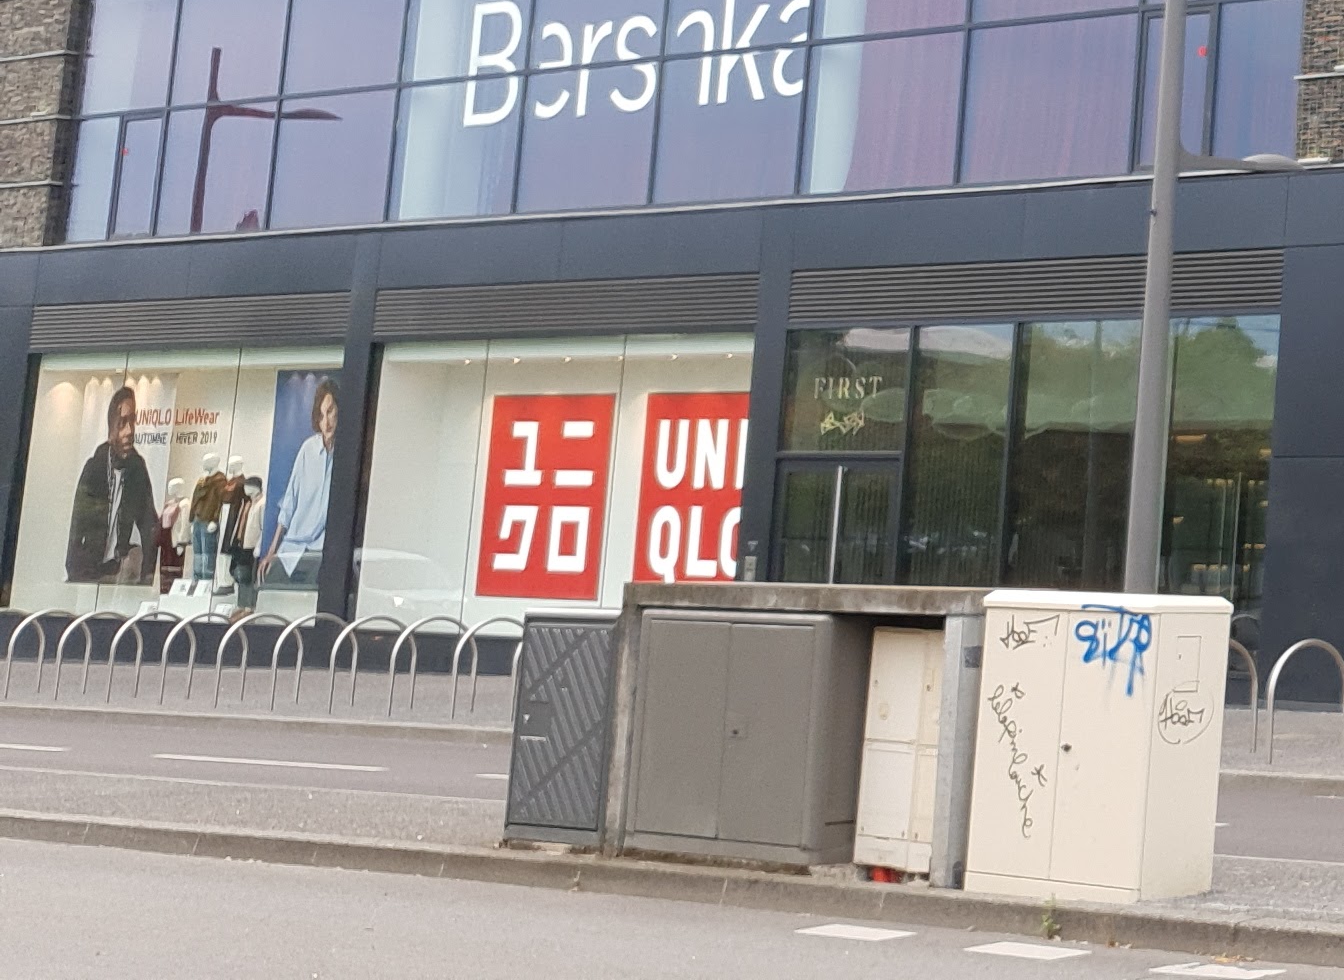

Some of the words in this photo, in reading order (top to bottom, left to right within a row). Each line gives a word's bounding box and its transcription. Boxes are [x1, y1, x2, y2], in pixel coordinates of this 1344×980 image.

[813, 375, 883, 400] FIRST
[174, 407, 220, 426] LifeWear
[656, 418, 749, 490] UNI
